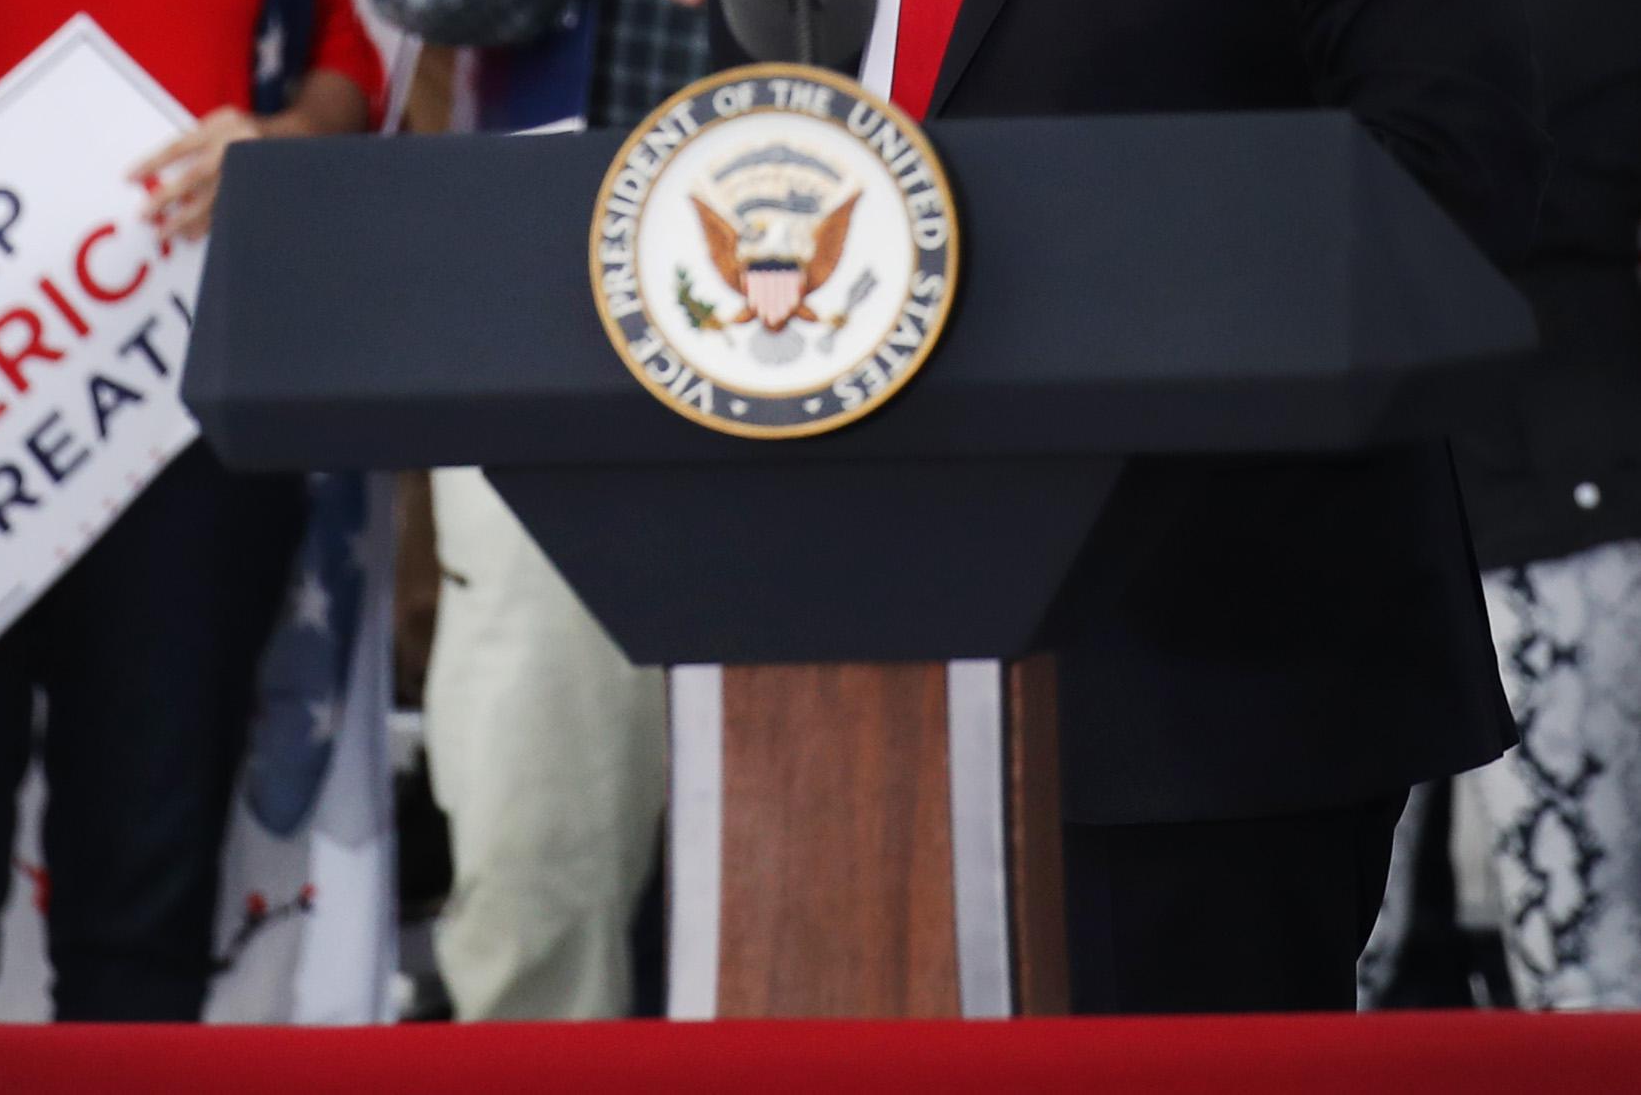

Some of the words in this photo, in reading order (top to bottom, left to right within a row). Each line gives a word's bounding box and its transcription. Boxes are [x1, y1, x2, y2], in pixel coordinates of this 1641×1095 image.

[711, 80, 758, 118] OF
[769, 79, 837, 118] THE
[601, 100, 701, 318] PRESIDENT
[846, 100, 949, 251] UNITED
[628, 326, 716, 413] VICE
[832, 270, 945, 412] STATES
